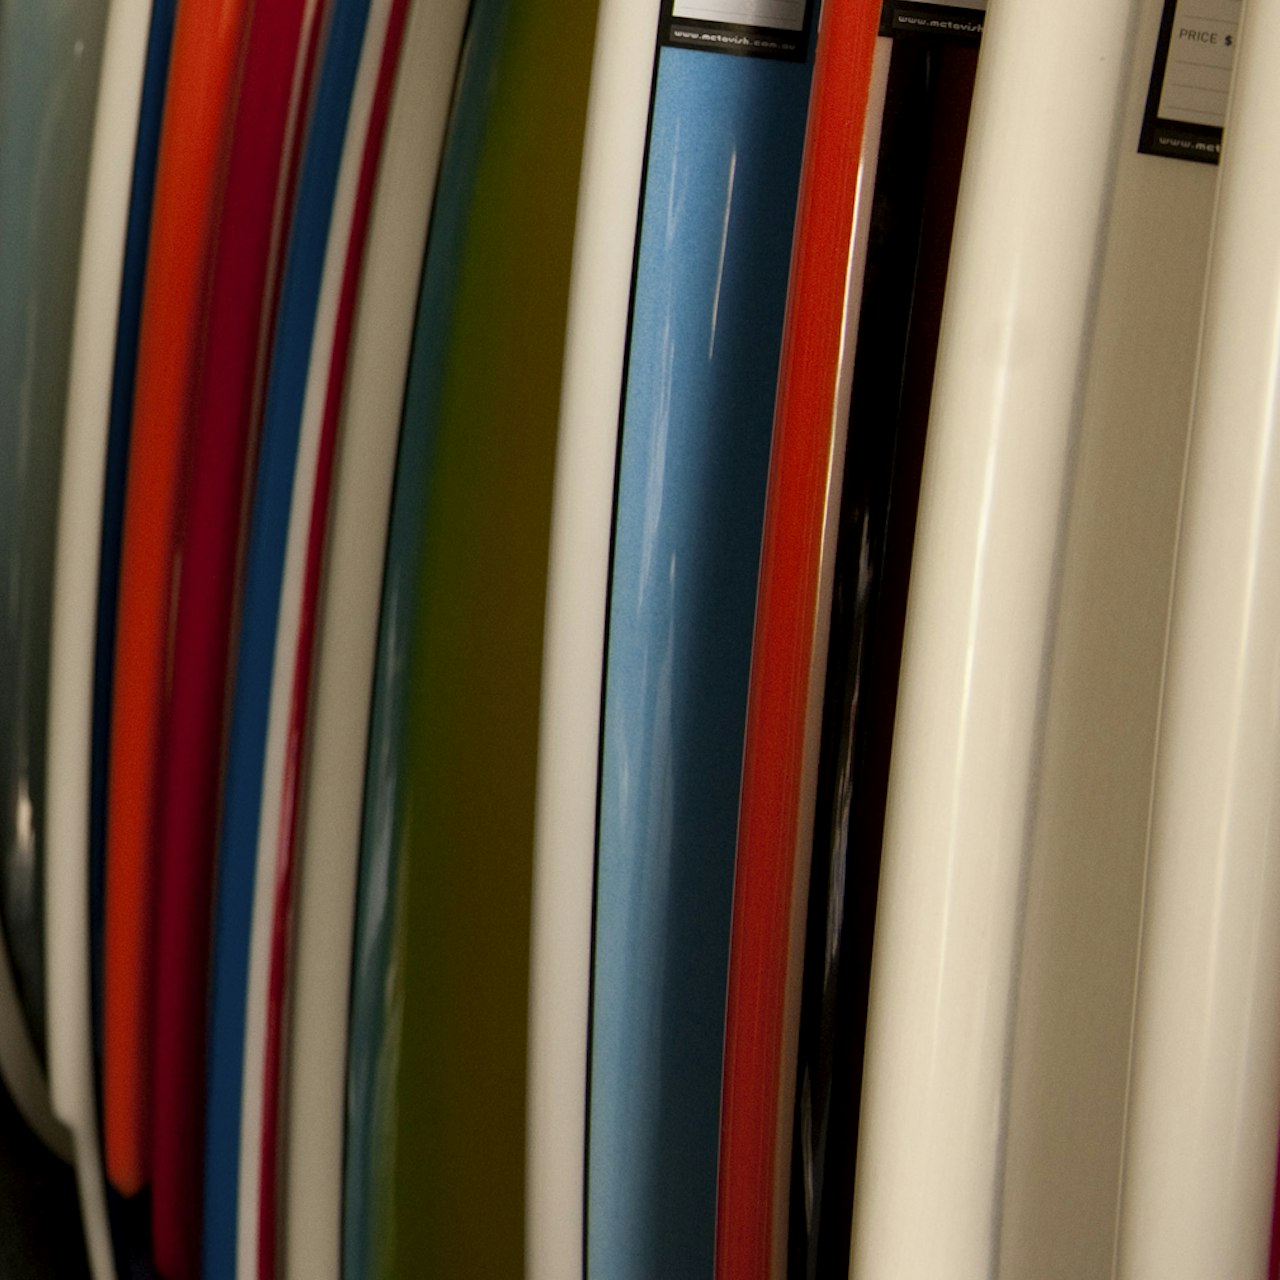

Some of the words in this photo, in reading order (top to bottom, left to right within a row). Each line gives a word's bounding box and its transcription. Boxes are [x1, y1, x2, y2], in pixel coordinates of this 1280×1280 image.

[673, 29, 797, 51] www.mctavish.com.au
[1179, 28, 1218, 45] PRICE
[1223, 34, 1233, 47] $
